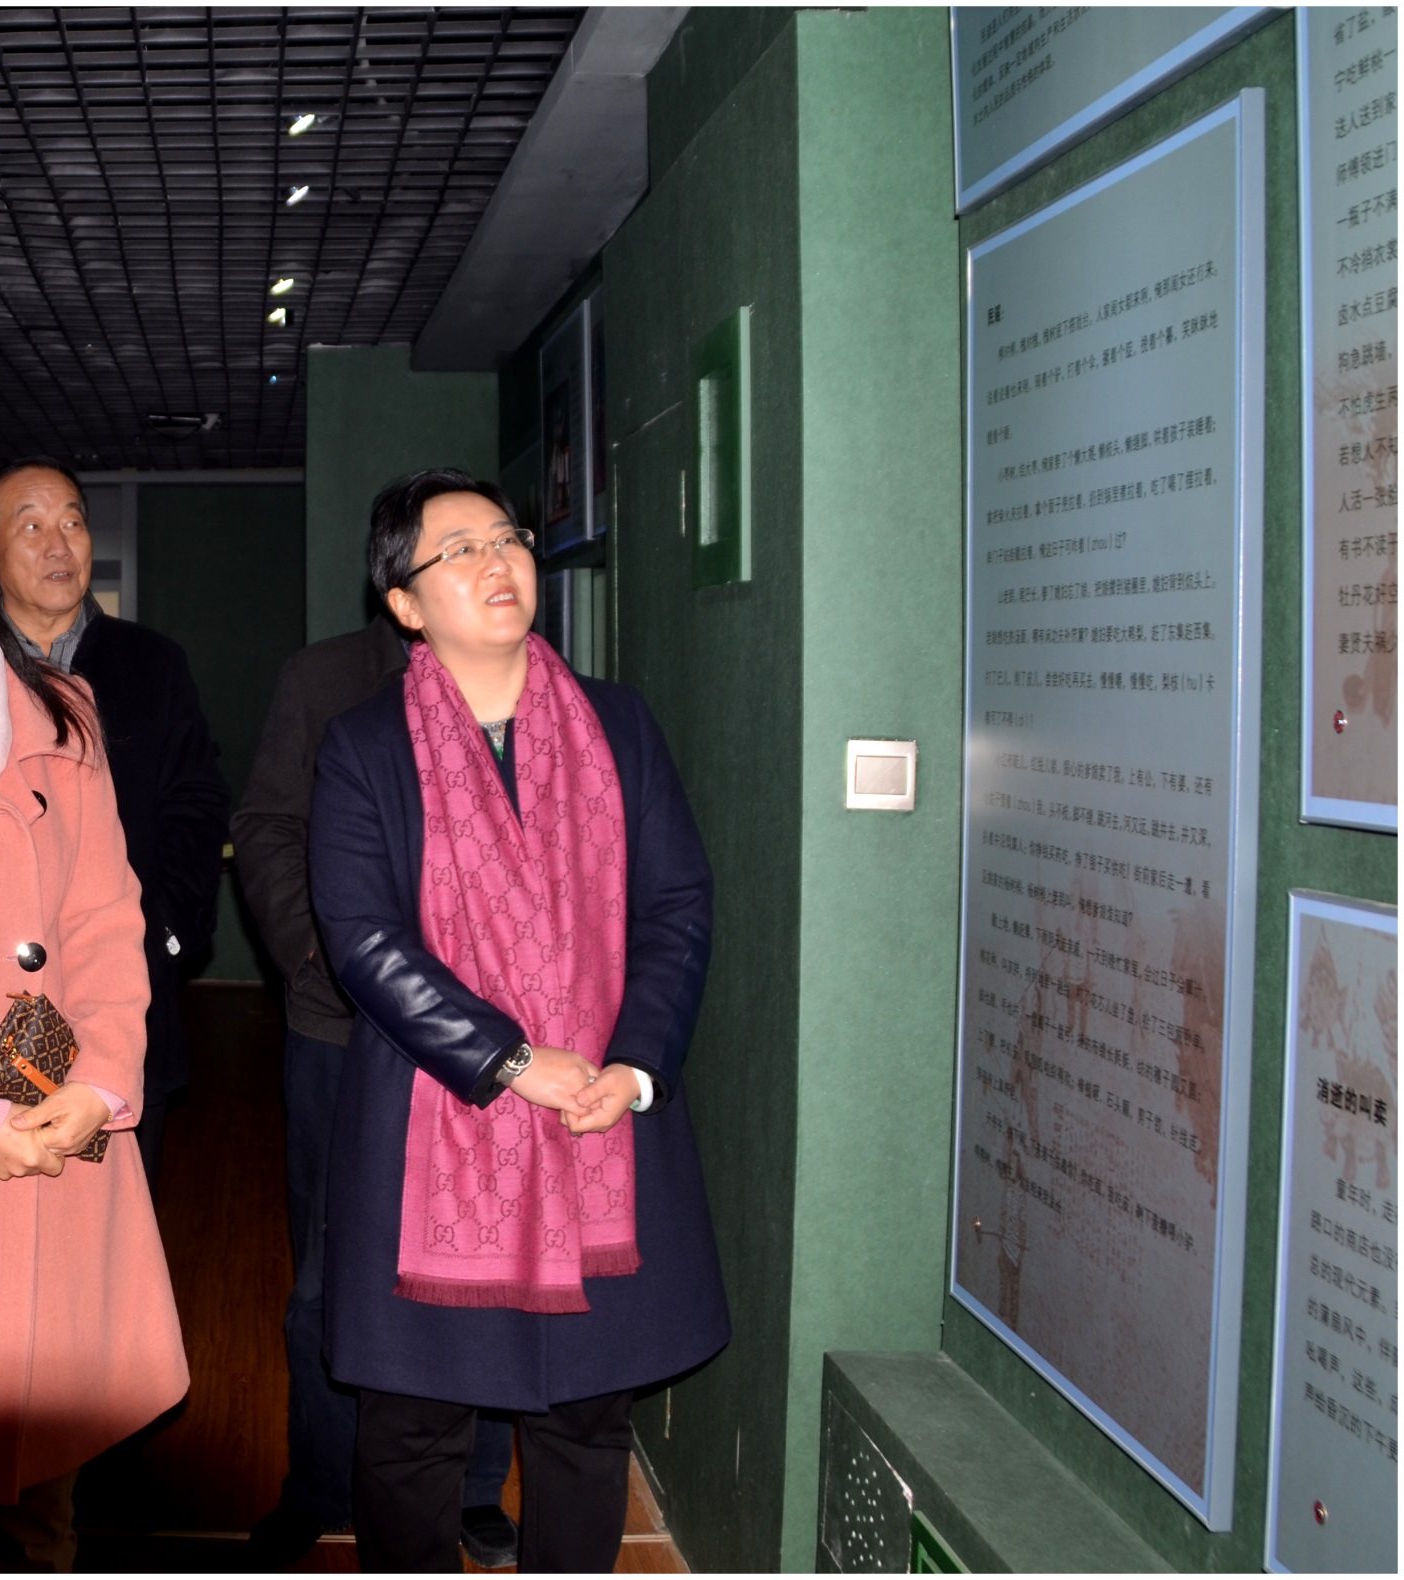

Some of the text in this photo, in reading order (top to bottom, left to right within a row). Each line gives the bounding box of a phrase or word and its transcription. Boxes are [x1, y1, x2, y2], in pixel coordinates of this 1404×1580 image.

[1335, 91, 1398, 140] 送人送到家
[1316, 1077, 1387, 1127] 消逝的叫卖
